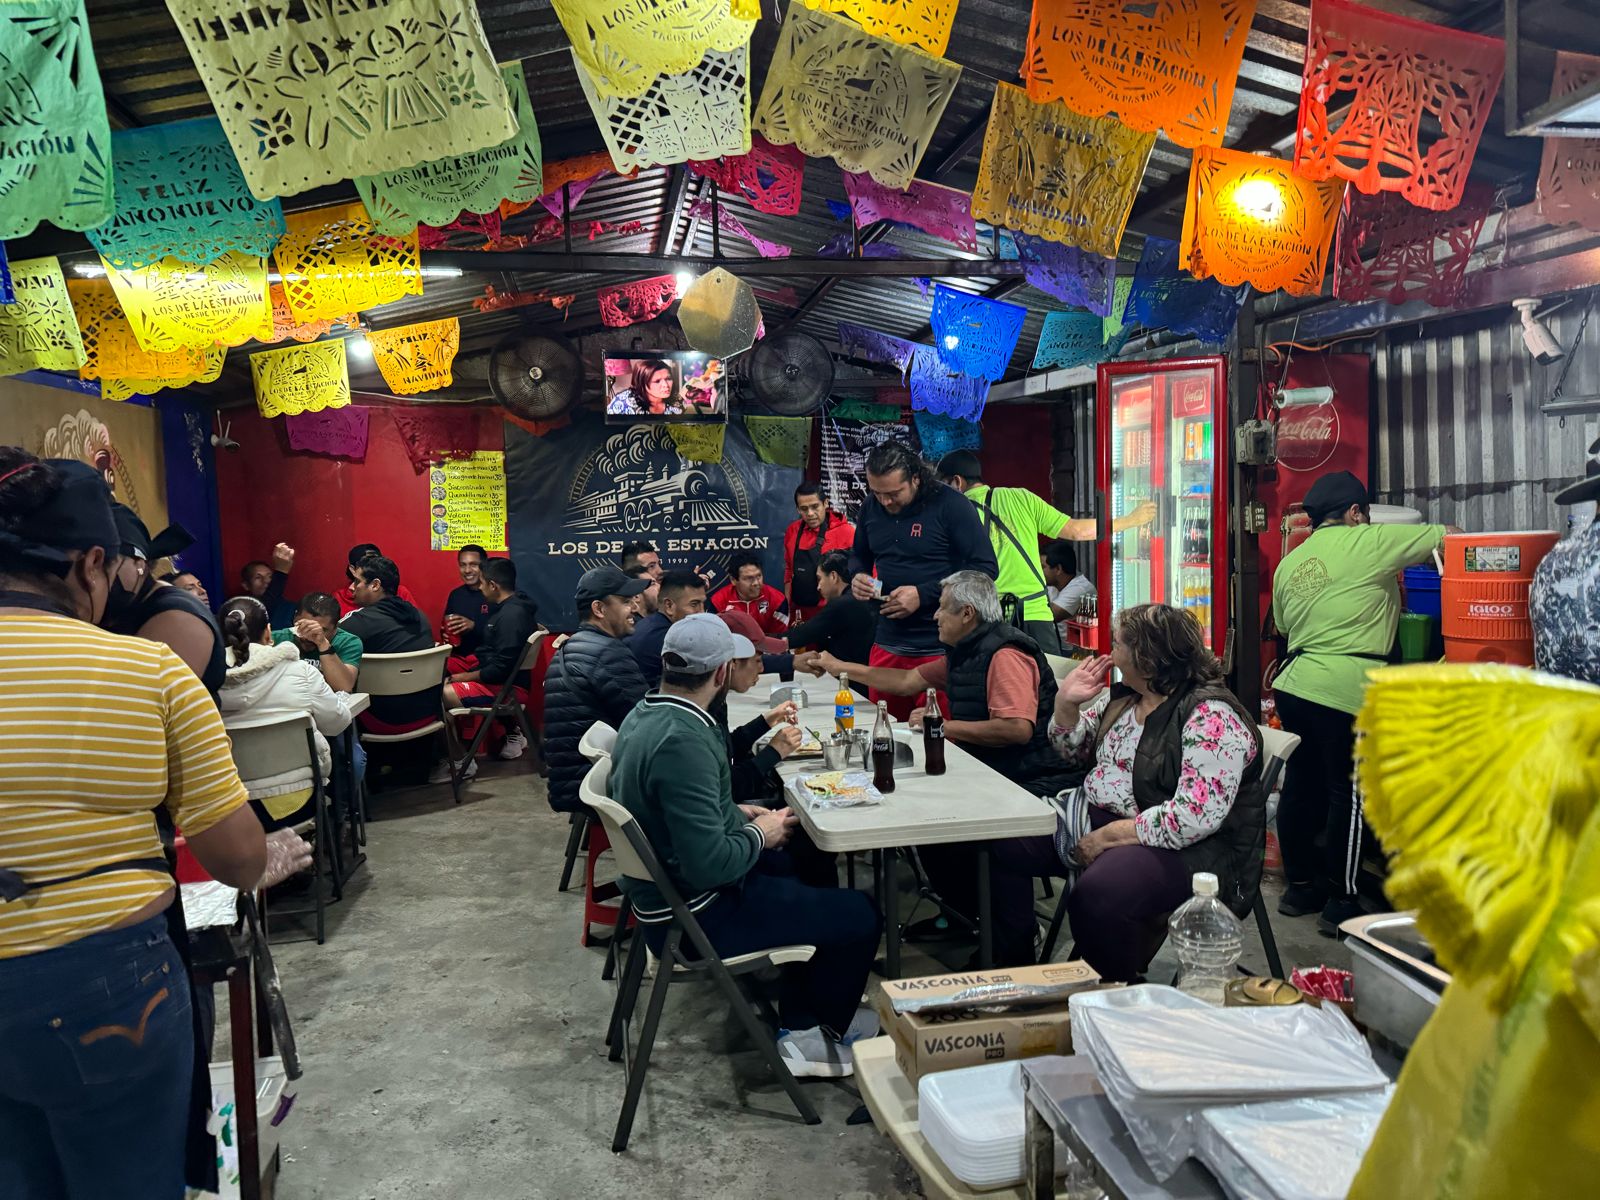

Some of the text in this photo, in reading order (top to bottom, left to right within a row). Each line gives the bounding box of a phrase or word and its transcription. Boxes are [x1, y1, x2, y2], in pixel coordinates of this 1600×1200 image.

[602, 4, 634, 29] LOS
[1052, 26, 1083, 45] LOS
[1110, 42, 1130, 63] LA
[1080, 64, 1106, 93] TACOS
[1122, 90, 1160, 103] PASTOR
[1131, 67, 1157, 83] 1990
[791, 90, 908, 146] LOS DE LA ESTACIÓN
[817, 113, 868, 138] DESDE 1990
[384, 171, 410, 188] LOS
[433, 162, 452, 174] LA
[423, 168, 480, 188] DESDE 1990
[136, 178, 212, 201] FELIZ
[1205, 226, 1223, 238] LOS
[1226, 232, 1239, 241] DE
[153, 305, 173, 316] LOS
[175, 303, 189, 313] DE
[193, 300, 208, 311] LA
[185, 308, 231, 319] DESDE 1990
[400, 333, 429, 344] FELIZ
[403, 369, 448, 384] NAVIDAD
[548, 534, 768, 555] LOS DE A ESTACIÓN
[1470, 604, 1512, 614] IGLOO
[986, 1050, 1004, 1058] PRO
